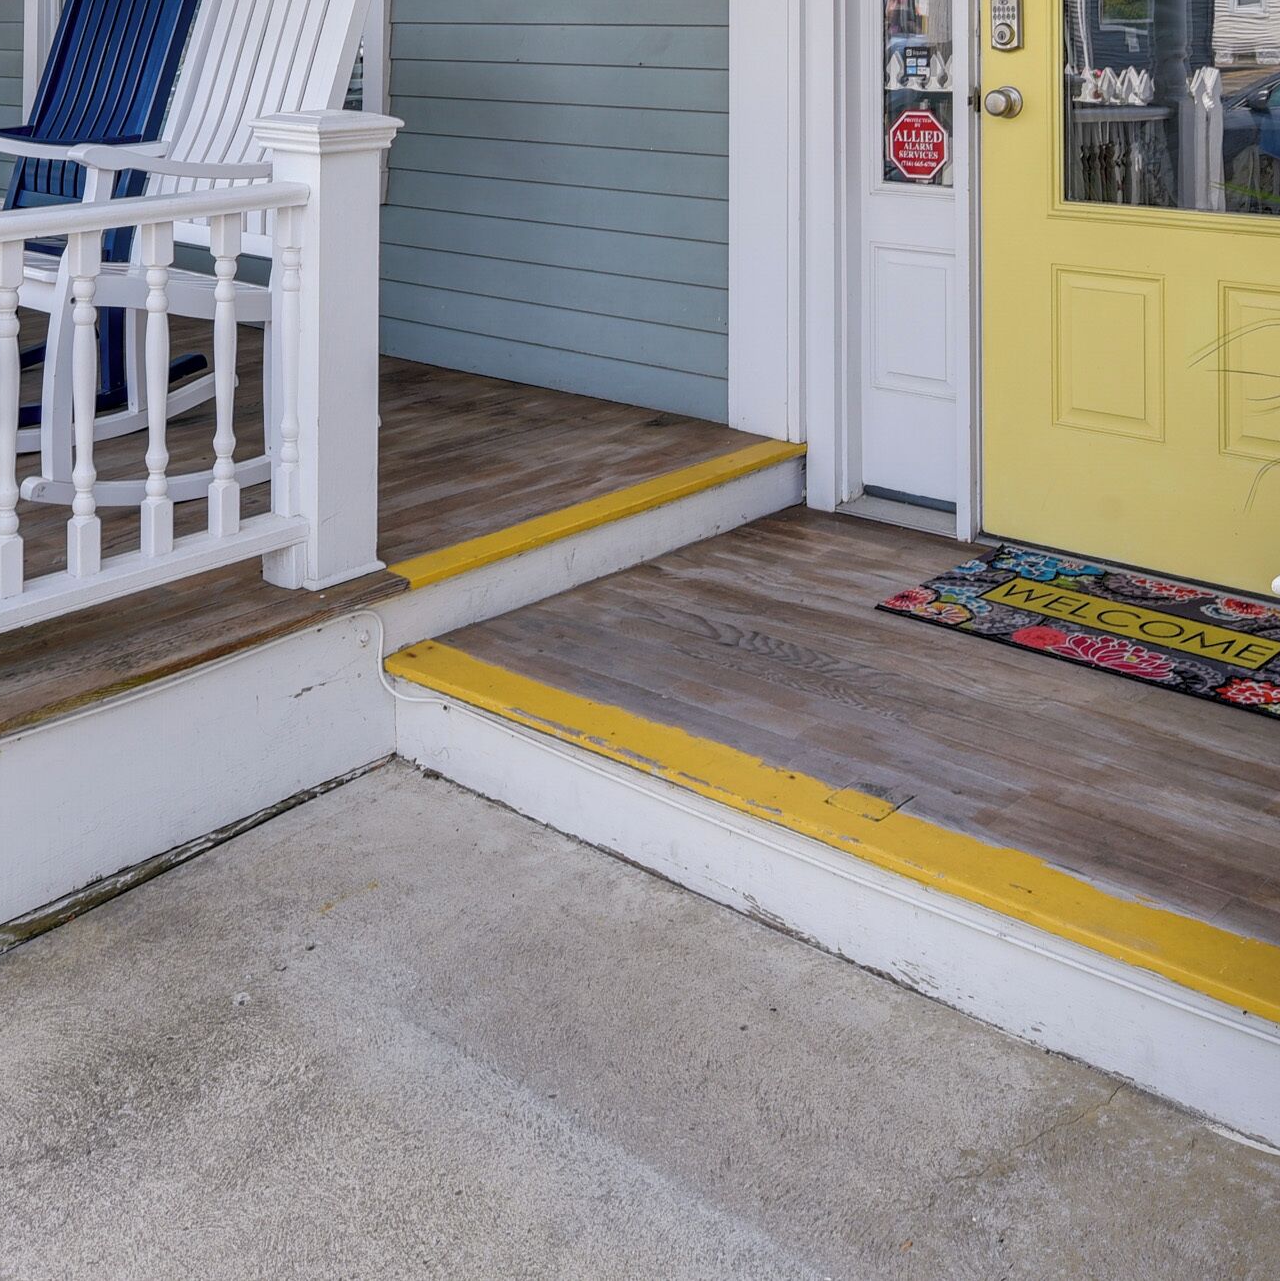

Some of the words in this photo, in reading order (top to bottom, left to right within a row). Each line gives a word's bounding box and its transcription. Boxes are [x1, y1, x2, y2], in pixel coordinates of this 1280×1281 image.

[894, 129, 943, 143] ALLIED
[903, 142, 934, 151] ALARM
[898, 149, 939, 159] SERVICES
